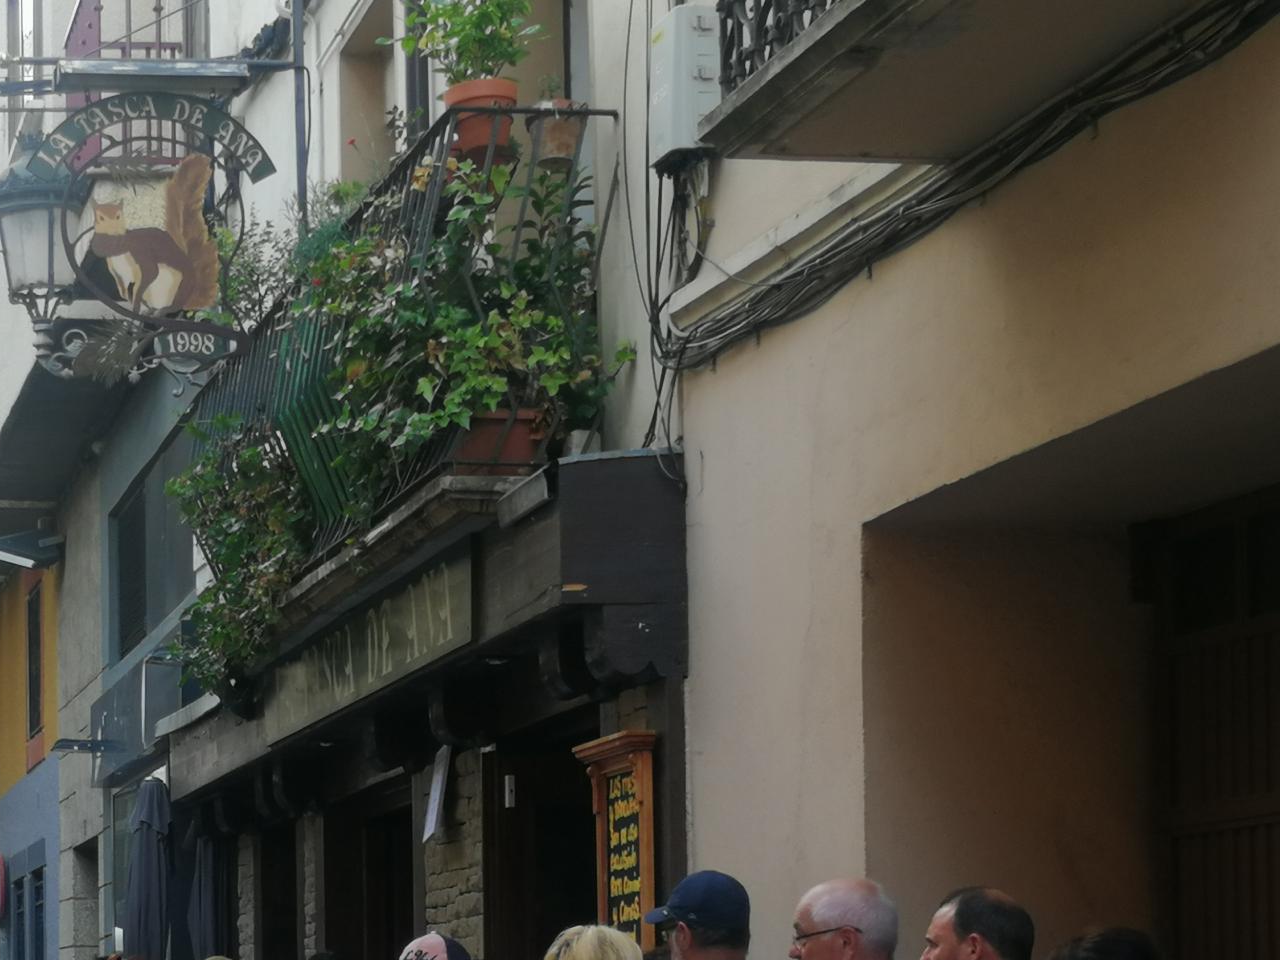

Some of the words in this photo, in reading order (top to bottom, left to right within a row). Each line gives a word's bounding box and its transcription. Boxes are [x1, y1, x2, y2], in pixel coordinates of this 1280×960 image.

[37, 134, 77, 169] LA
[74, 95, 157, 134] TASCA
[174, 99, 208, 128] DE
[216, 121, 263, 173] ANA
[166, 332, 215, 354] 1998
[366, 599, 393, 684] DE
[406, 562, 453, 664] ANA
